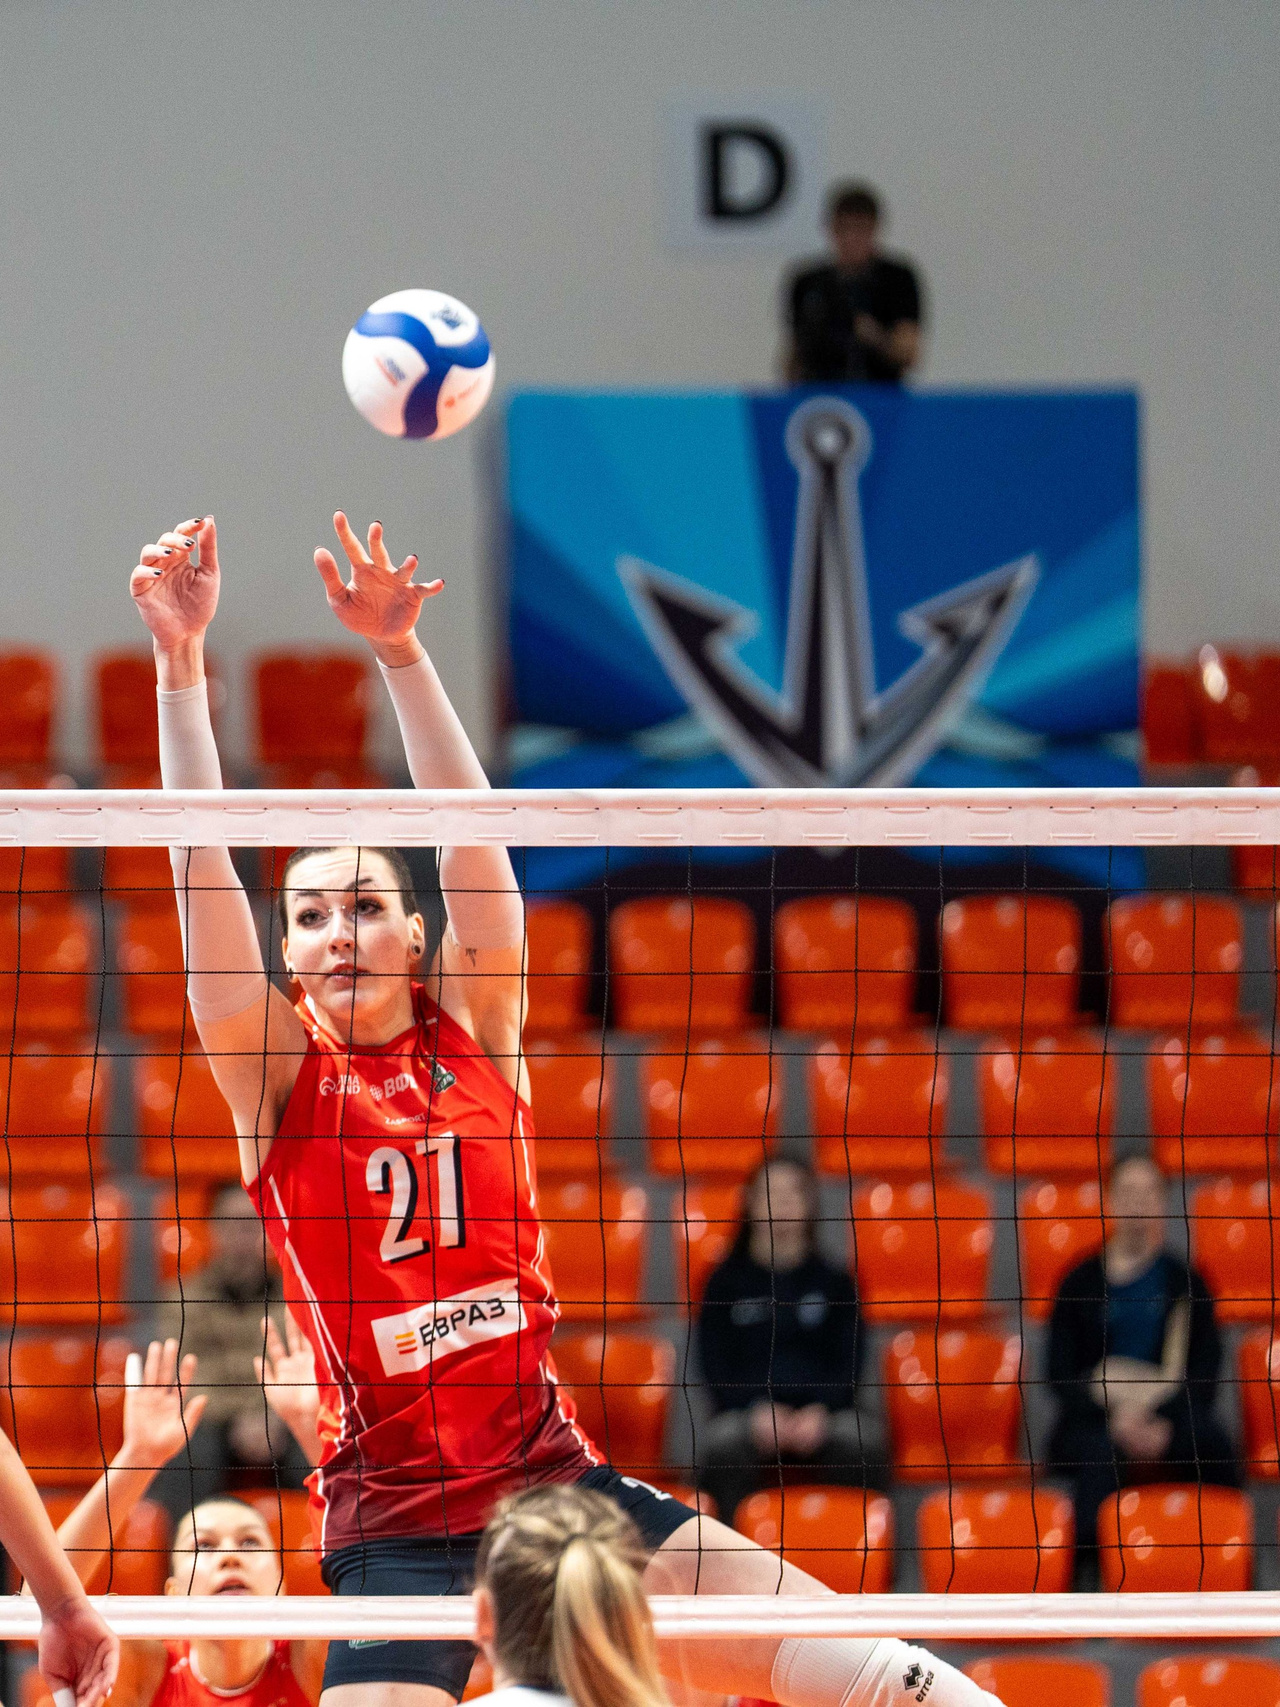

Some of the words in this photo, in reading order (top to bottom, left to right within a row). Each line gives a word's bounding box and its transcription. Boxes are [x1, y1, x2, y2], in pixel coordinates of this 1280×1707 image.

[700, 123, 792, 223] D
[366, 1131, 466, 1264] 27
[419, 1297, 505, 1347] ЕВРАЗ
